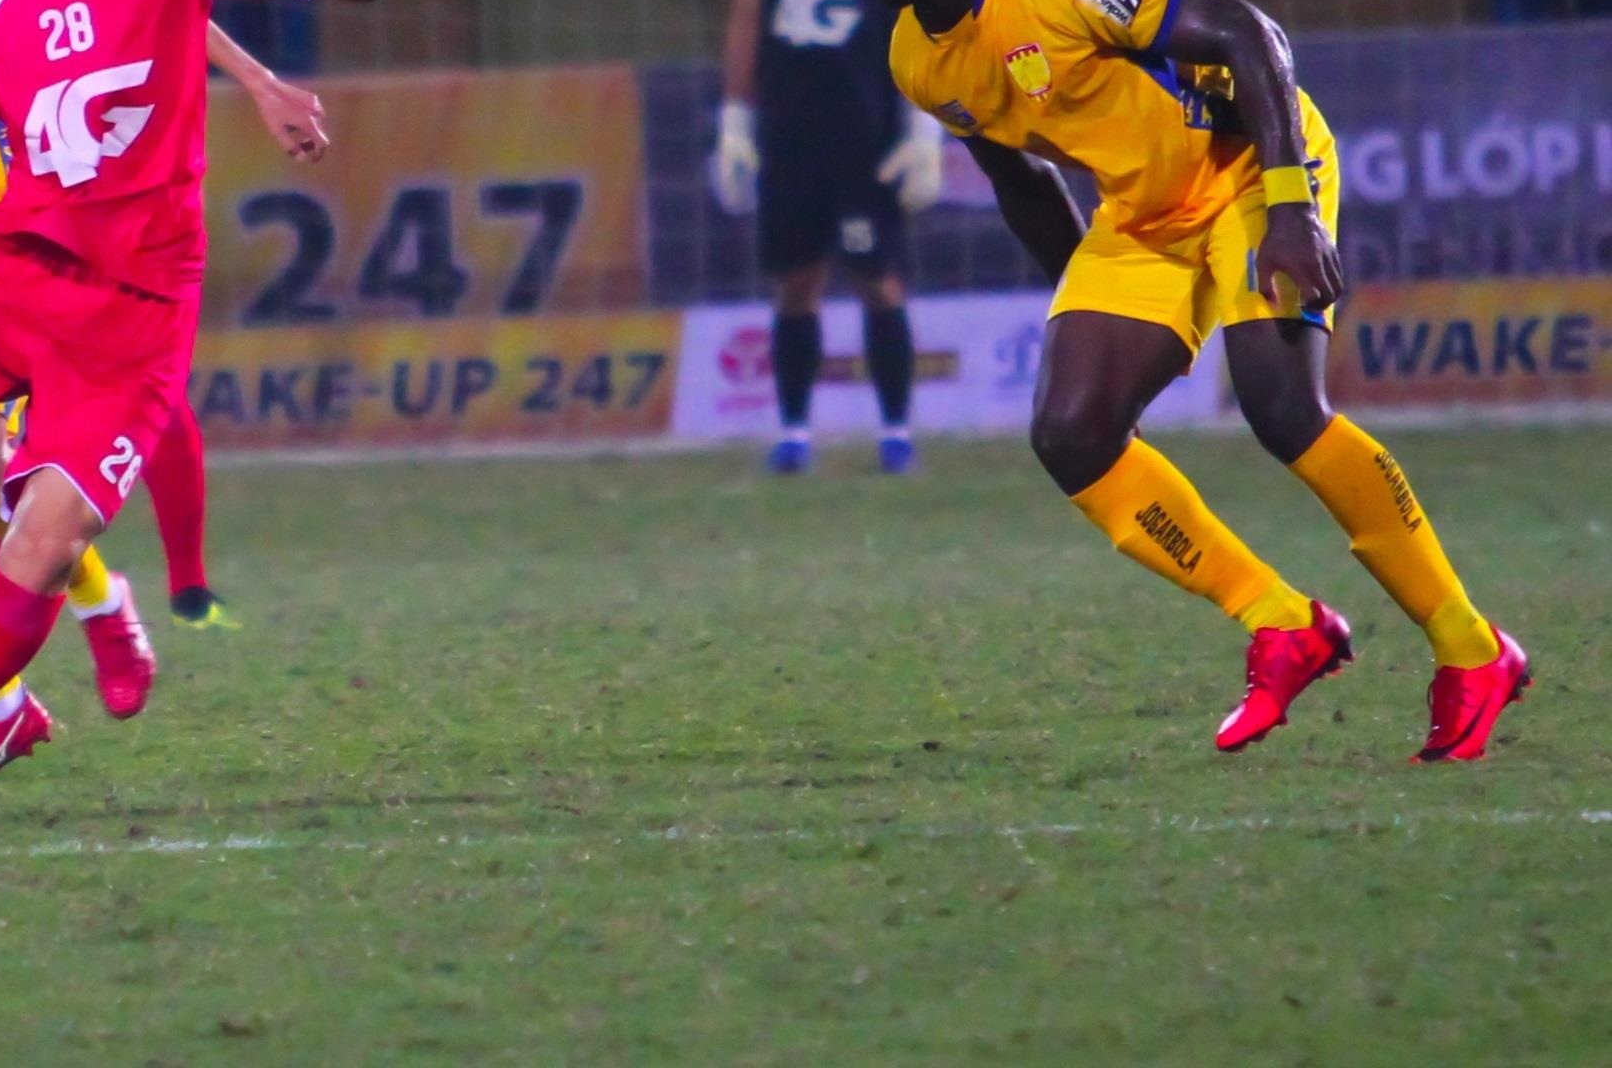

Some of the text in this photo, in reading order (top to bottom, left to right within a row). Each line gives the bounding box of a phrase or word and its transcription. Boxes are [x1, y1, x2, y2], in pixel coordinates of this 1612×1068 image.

[39, 2, 94, 61] 28
[24, 60, 155, 188] 4G
[1339, 129, 1408, 202] G
[237, 180, 584, 326] 247
[188, 353, 667, 422] AKE-UP 247
